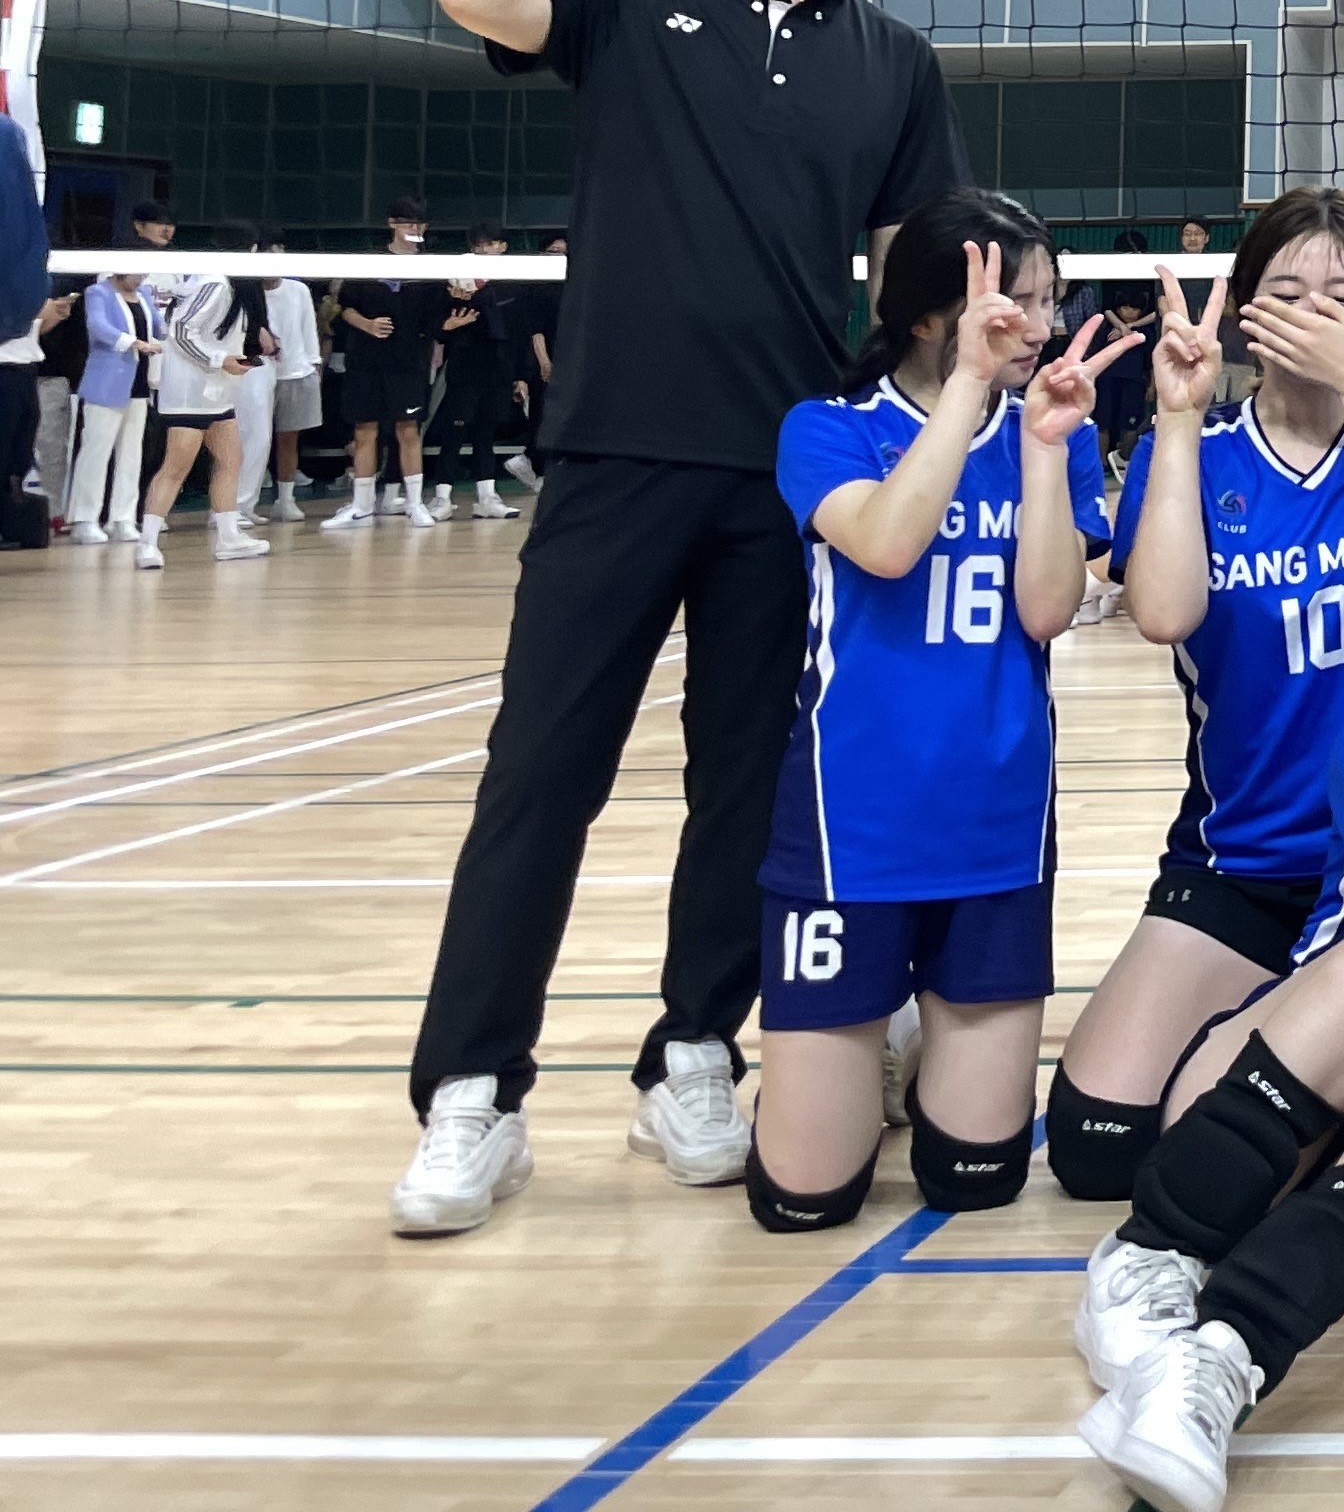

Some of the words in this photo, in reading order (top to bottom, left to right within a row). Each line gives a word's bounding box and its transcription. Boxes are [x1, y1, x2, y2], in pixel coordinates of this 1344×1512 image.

[1209, 546, 1307, 591] SANG
[924, 554, 1005, 644] 16
[784, 910, 844, 981] 16
[1258, 1079, 1291, 1113] star
[1093, 1121, 1132, 1134] star
